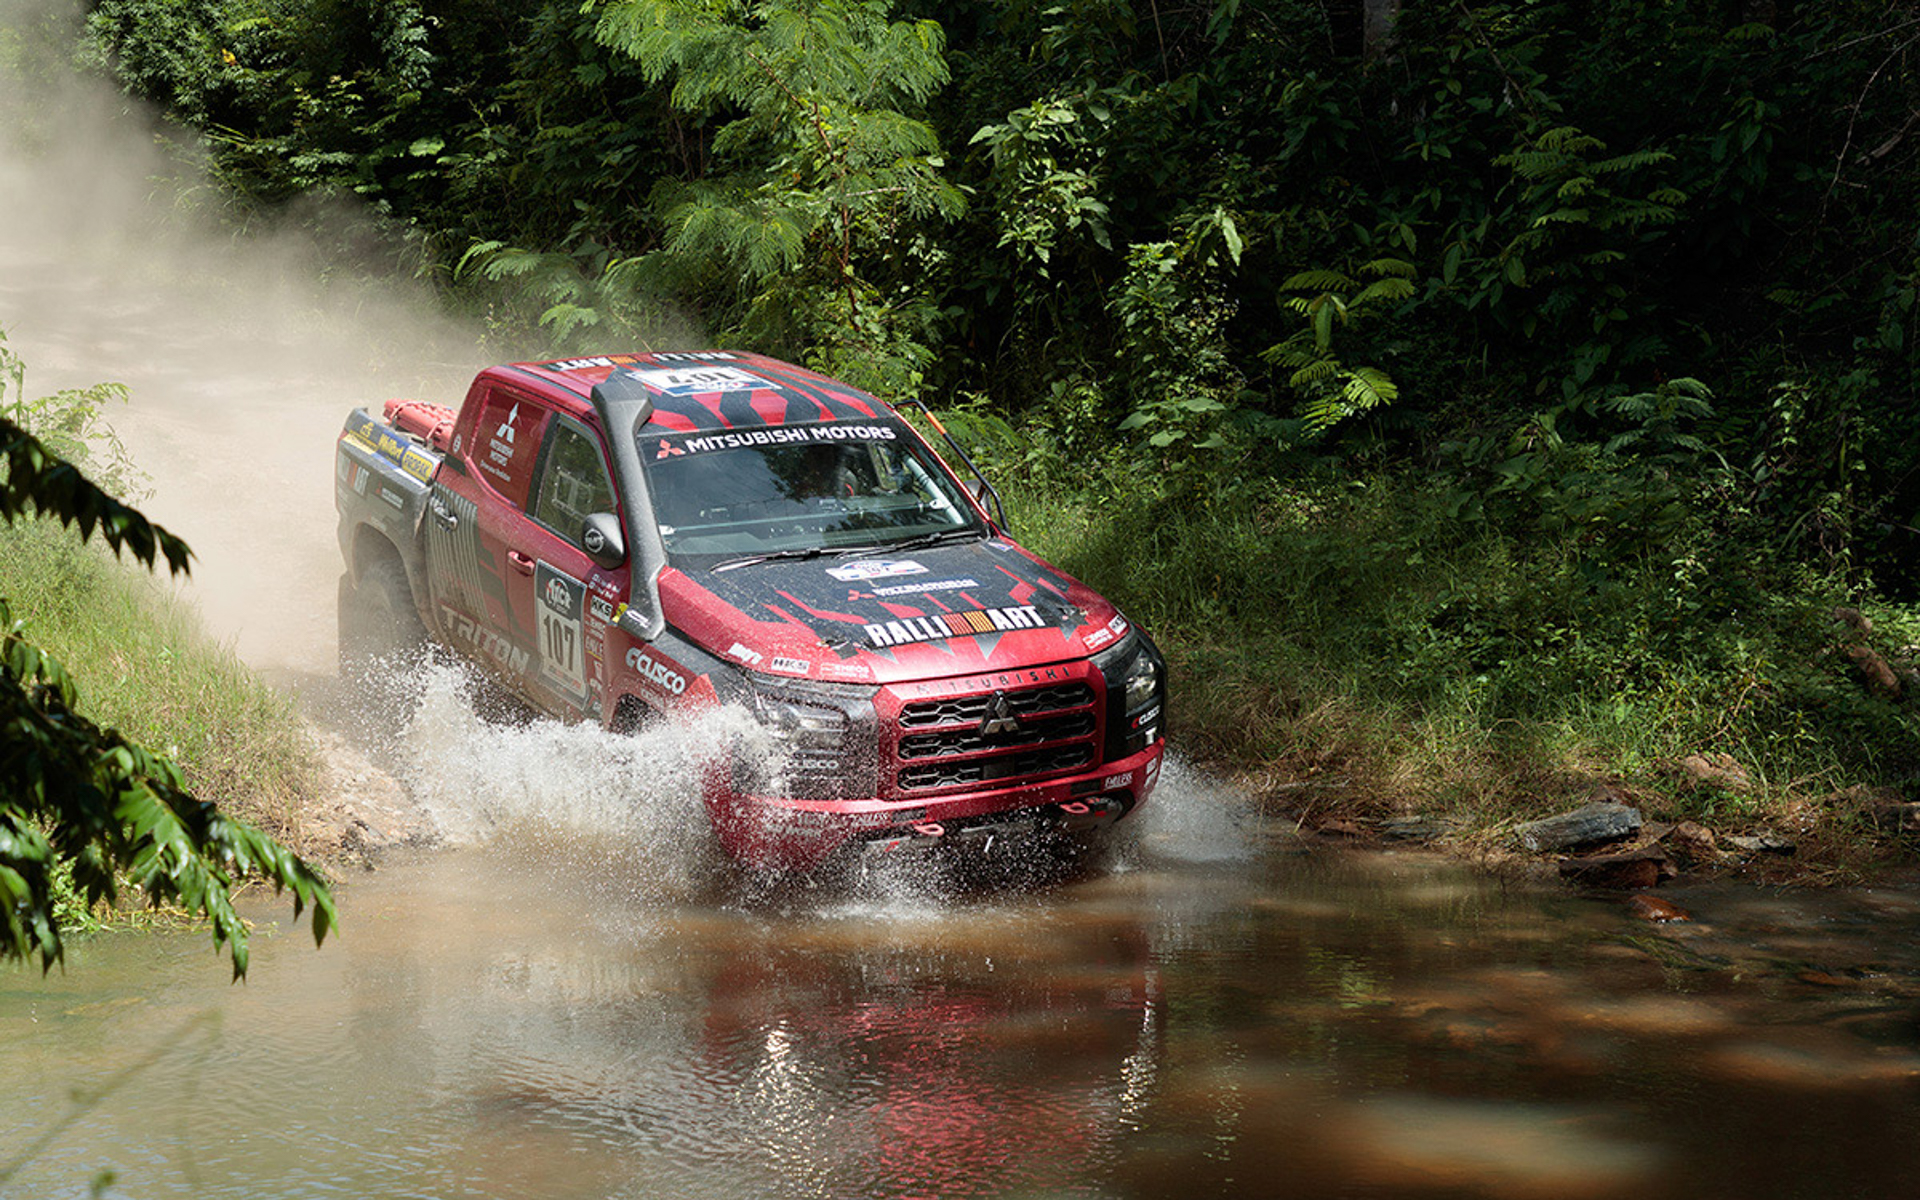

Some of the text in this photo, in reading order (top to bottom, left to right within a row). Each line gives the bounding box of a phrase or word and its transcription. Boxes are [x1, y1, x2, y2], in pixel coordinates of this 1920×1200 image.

[685, 425, 897, 454] MITSUBISHI MOTORS
[591, 595, 613, 617] HKS
[440, 604, 530, 676] TRITON
[543, 613, 576, 672] 107
[863, 605, 1046, 648] RALLI ART
[635, 652, 686, 695] CUSCO
[773, 656, 809, 673] HKS
[916, 666, 1070, 695] MITSUBISHI
